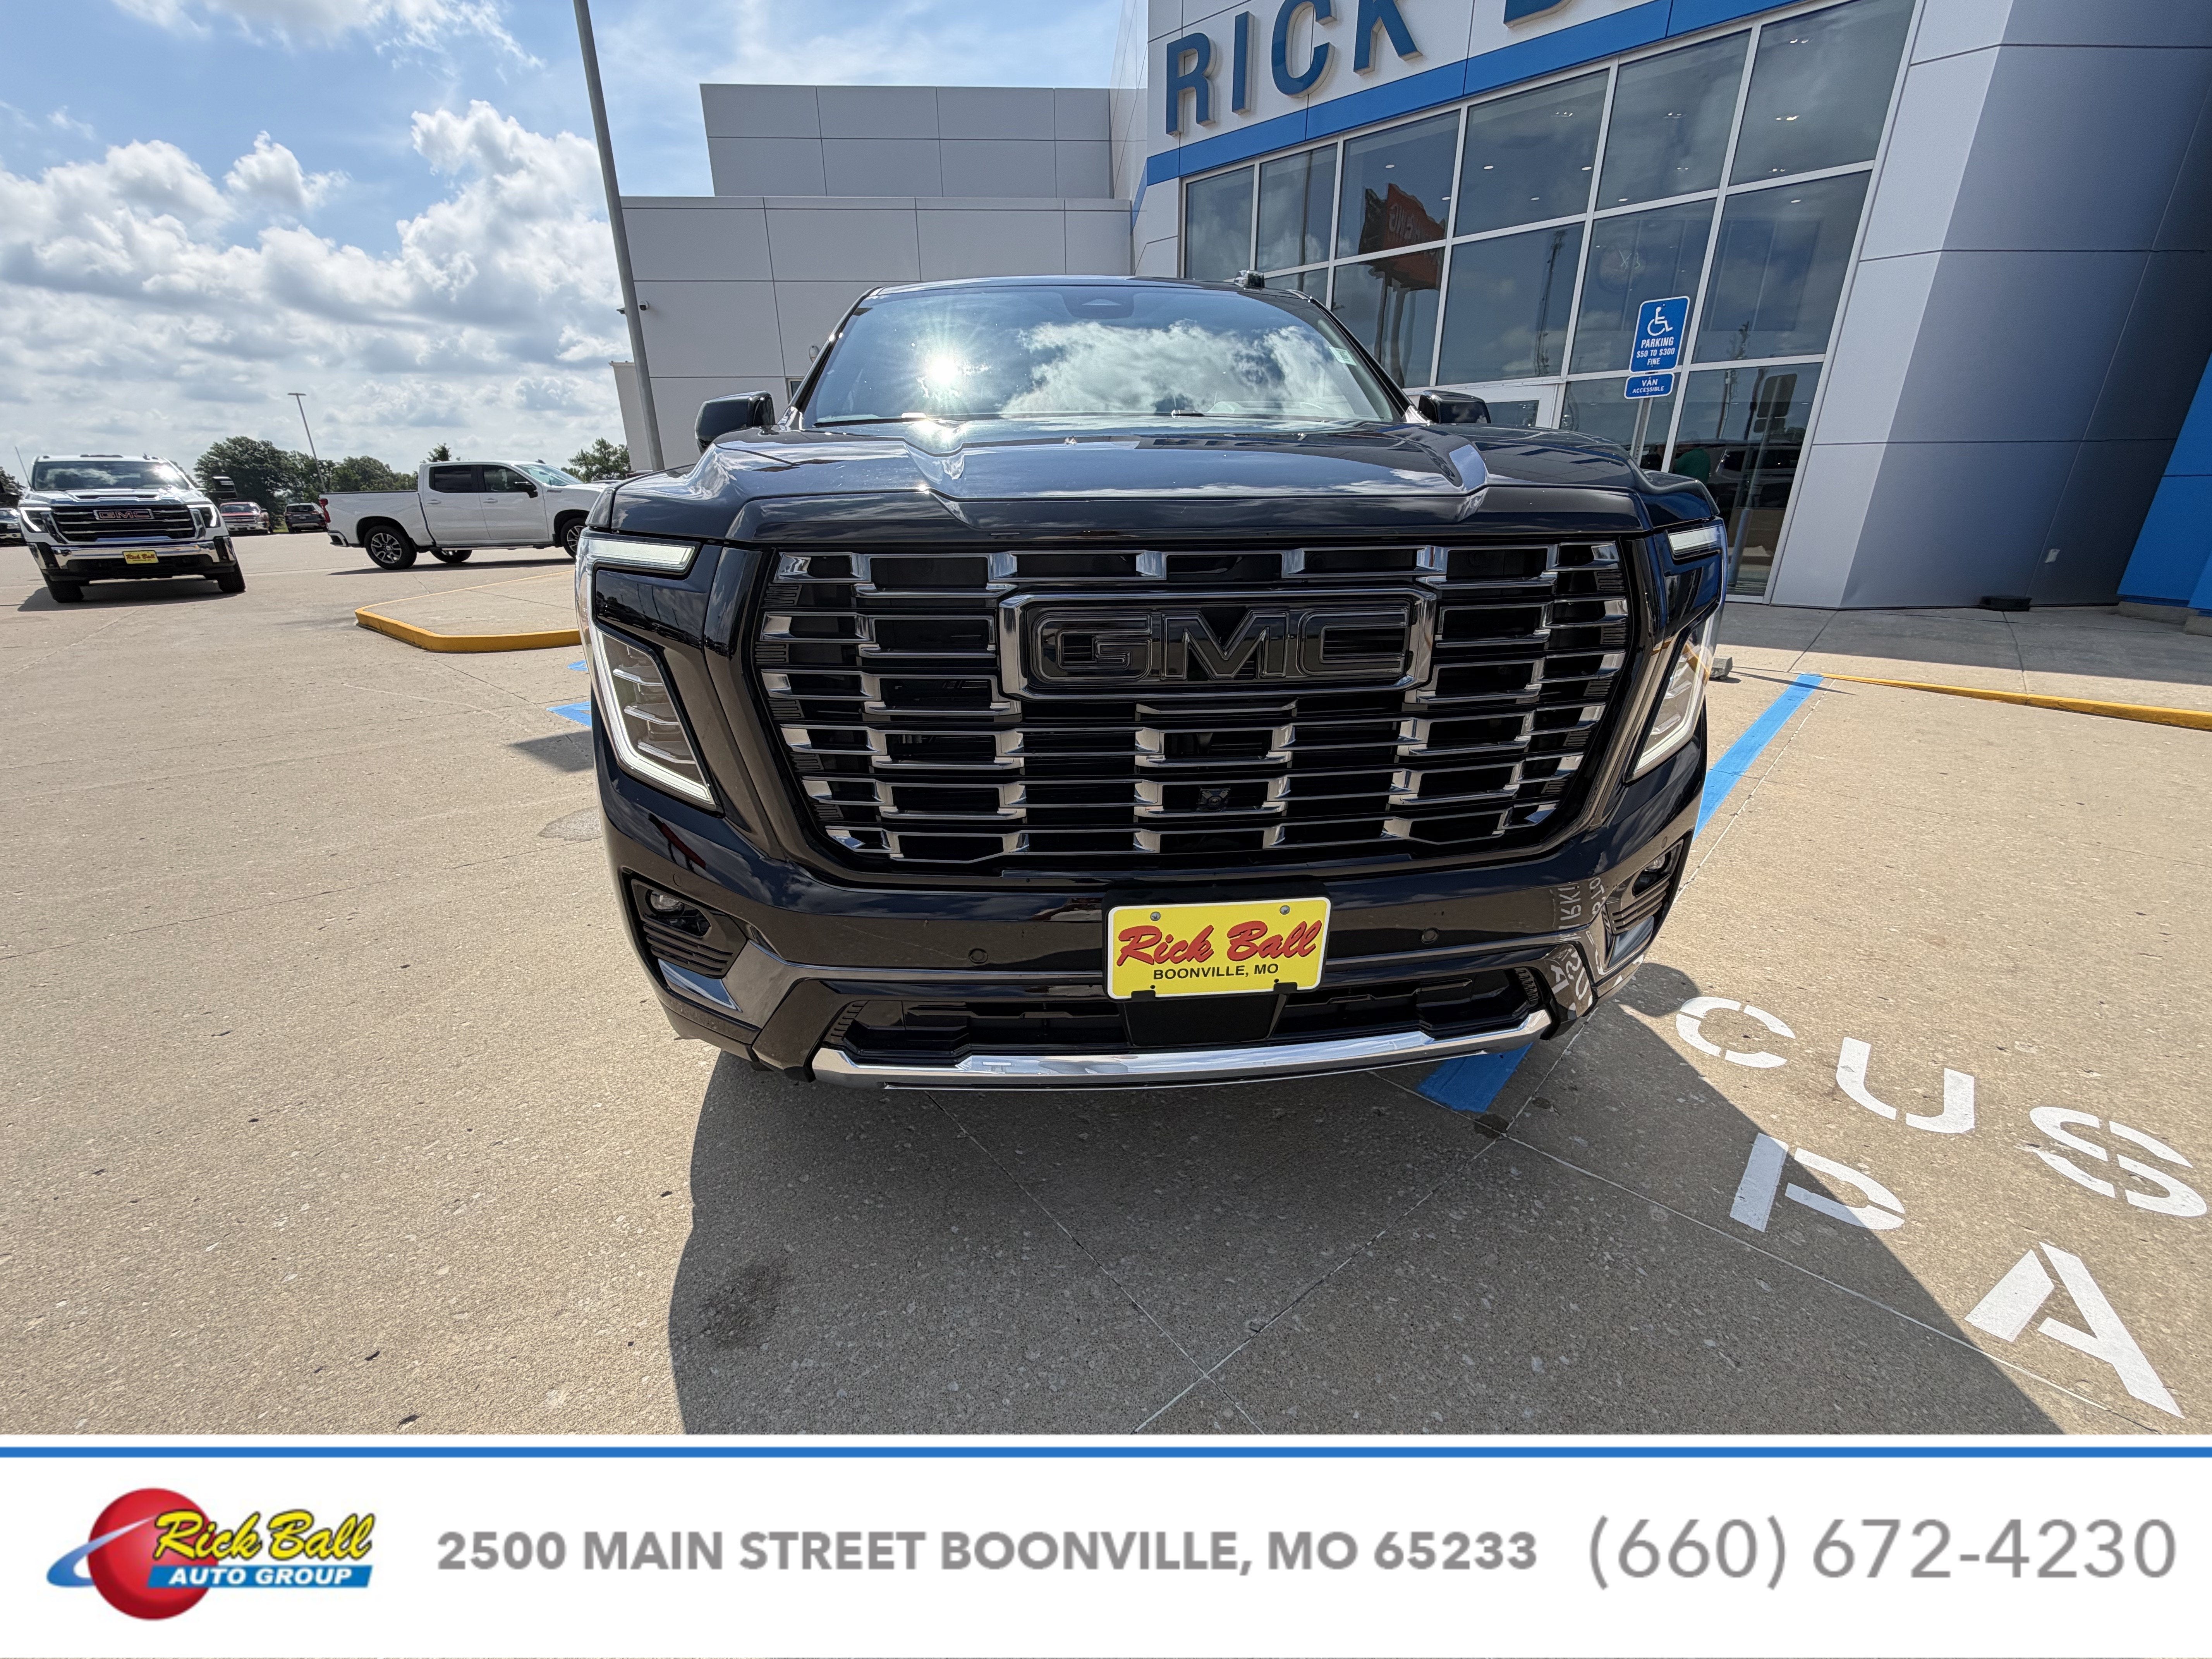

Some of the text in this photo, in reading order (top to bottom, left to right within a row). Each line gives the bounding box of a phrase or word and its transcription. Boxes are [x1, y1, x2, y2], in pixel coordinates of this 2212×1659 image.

[1166, 0, 1423, 136] RICK
[1641, 337, 1674, 349] PARKING
[1647, 357, 1661, 366] FINE
[1642, 378, 1658, 387] VAN
[99, 510, 150, 519] GMC
[1030, 606, 1410, 682] GMC
[1116, 920, 1322, 967] Rick Ball
[1153, 963, 1279, 980] BOONVILLE, MO
